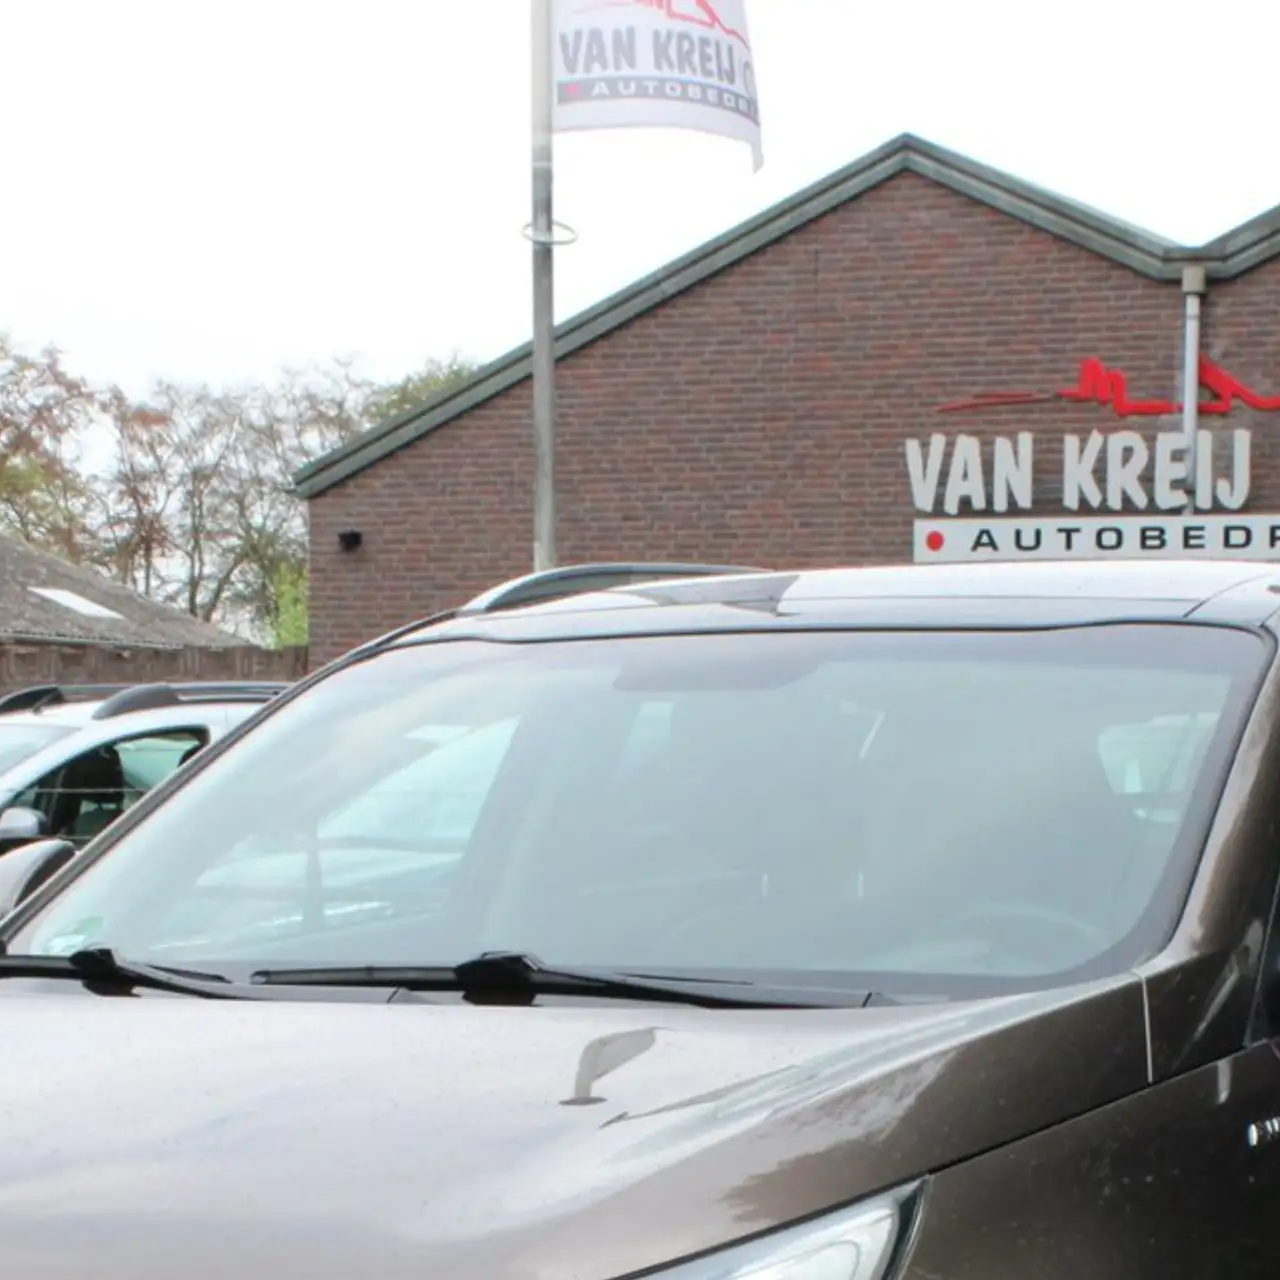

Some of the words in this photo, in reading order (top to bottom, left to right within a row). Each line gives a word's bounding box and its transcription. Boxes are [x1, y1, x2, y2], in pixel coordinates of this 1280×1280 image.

[559, 26, 637, 74] VAN
[652, 28, 735, 86] KREIJ
[905, 431, 1034, 515] VAN
[1062, 429, 1252, 512] KREIJ
